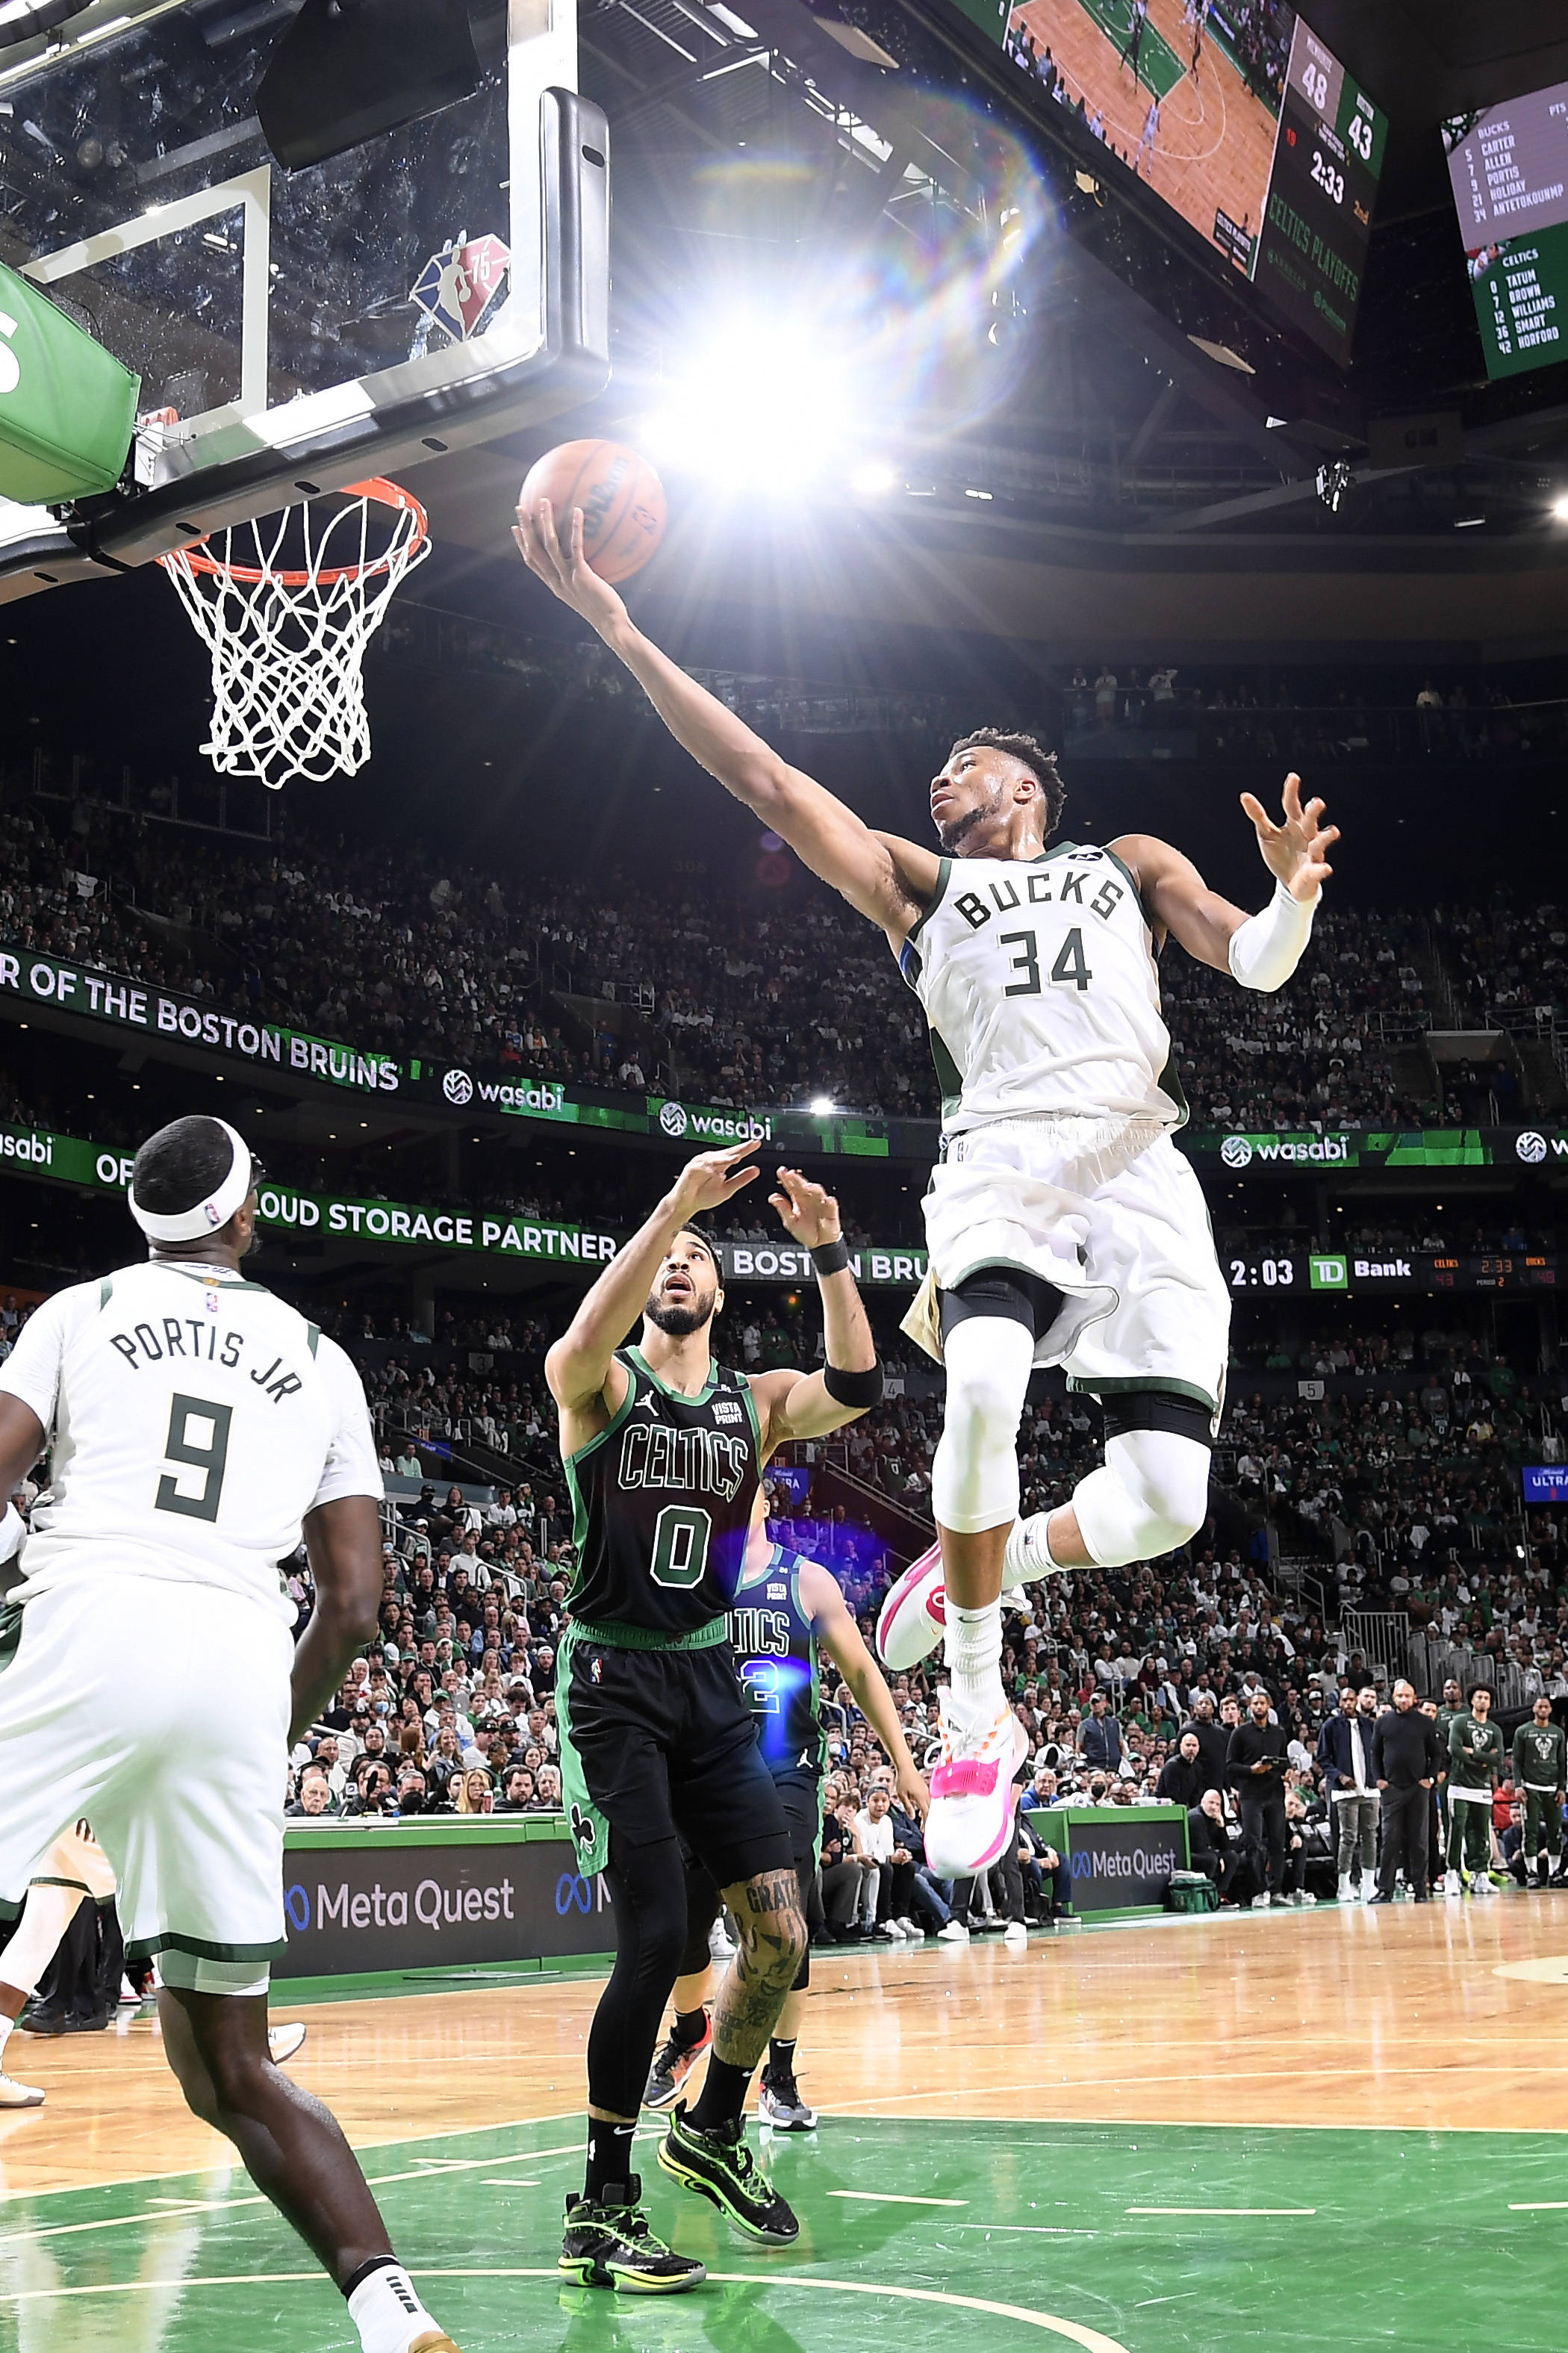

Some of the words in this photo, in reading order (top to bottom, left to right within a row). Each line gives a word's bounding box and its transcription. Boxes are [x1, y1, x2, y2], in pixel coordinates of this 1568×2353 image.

[1302, 63, 1328, 109] 48
[1549, 103, 1567, 116] PTS
[1348, 114, 1372, 160] 43
[1478, 121, 1510, 139] BUCKS
[1465, 149, 1472, 162] 5
[1481, 134, 1515, 156] CARTER
[1310, 151, 1344, 204] 2:33
[1468, 164, 1474, 176] 7
[1484, 152, 1512, 172] ALLEN
[1471, 179, 1478, 192] 9
[1487, 166, 1520, 187] PORTIS
[1472, 193, 1483, 208] 21
[1490, 179, 1526, 202] HOLIDAY
[1474, 208, 1487, 223] 34
[1270, 193, 1310, 253] CELTICS
[1312, 235, 1358, 302] PLAYOFFS
[1502, 248, 1540, 268] CELTICS
[471, 250, 491, 284] 75
[1490, 280, 1497, 293] 0
[1505, 268, 1537, 288] TATUM
[1493, 296, 1499, 308] 7
[1508, 283, 1541, 304] BROWN
[1494, 310, 1505, 324] 12
[1511, 295, 1556, 319] WILLIAMS
[1496, 326, 1509, 340] 36
[1514, 314, 1546, 335] SMART
[1499, 340, 1512, 355] 42
[1518, 326, 1560, 349] HORFORD
[953, 871, 1124, 930] BUCKS
[998, 927, 1093, 998] 34
[30, 963, 78, 1001] OF
[84, 976, 148, 1025] THE
[158, 998, 280, 1062] BOSTON
[290, 1037, 399, 1090] BRUINS
[478, 1081, 564, 1113] wasabi
[691, 1113, 771, 1141] wasabi
[1257, 1135, 1348, 1160] wasabi
[252, 1191, 320, 1227] OUD
[329, 1204, 473, 1245] STORAGE
[482, 1221, 617, 1261] PARTNER
[733, 1250, 862, 1278] BOSTN
[1231, 1259, 1294, 1286] 2:03
[1313, 1261, 1344, 1283] TD
[1354, 1259, 1412, 1277] Bank
[1499, 1277, 1505, 1287] 2
[110, 1318, 244, 1370] PORTIS
[251, 1357, 302, 1405] JR
[888, 1381, 896, 1395] 4
[1307, 1383, 1316, 1397] 5
[712, 1402, 742, 1415] VISTA
[715, 1413, 743, 1425] PRINT
[155, 1393, 234, 1523] 9
[617, 1423, 749, 1503] CELTICS
[650, 1504, 712, 1589] 0
[724, 1608, 790, 1658] LTICS
[732, 1657, 780, 1714] 2
[1092, 1850, 1132, 1878] Meta
[1133, 1847, 1176, 1879] Quest
[317, 1883, 408, 1930] Meta
[414, 1878, 515, 1930] Quest
